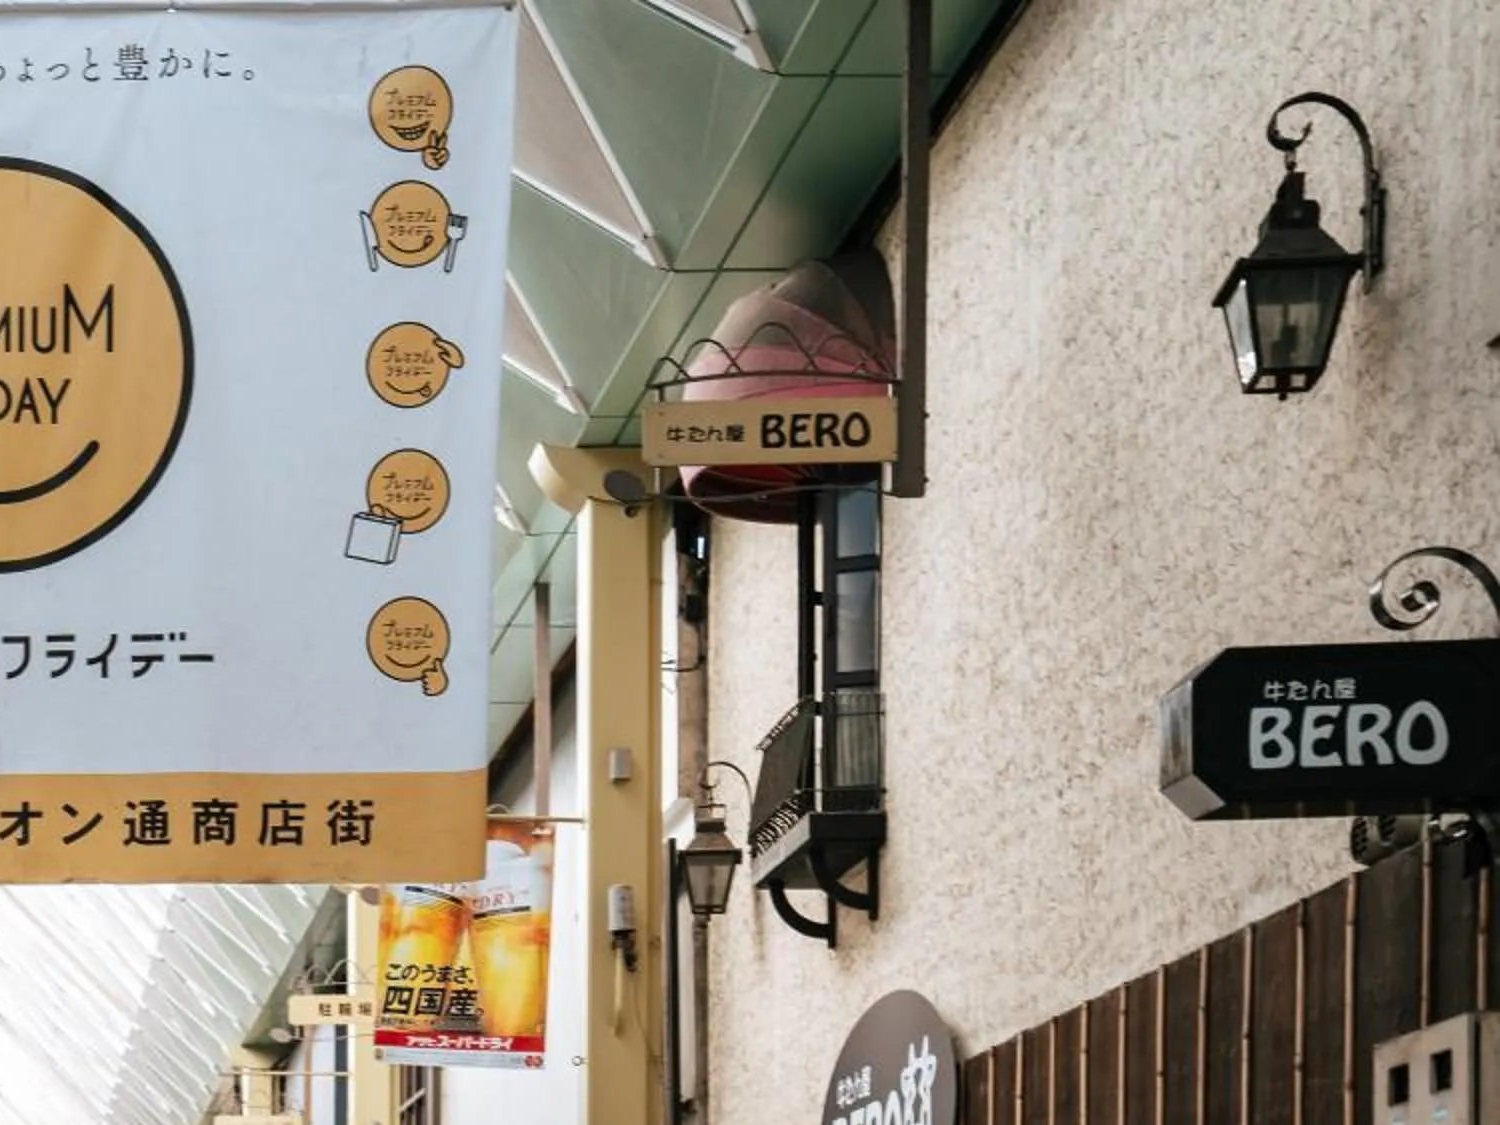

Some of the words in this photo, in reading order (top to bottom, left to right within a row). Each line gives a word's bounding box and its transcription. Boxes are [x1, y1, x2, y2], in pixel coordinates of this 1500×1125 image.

[666, 425, 745, 443] 牛たん屋
[760, 411, 872, 449] BERO
[1263, 677, 1357, 701] 牛たん屋
[1248, 700, 1450, 769] BERO
[385, 962, 475, 984] このうまさ、
